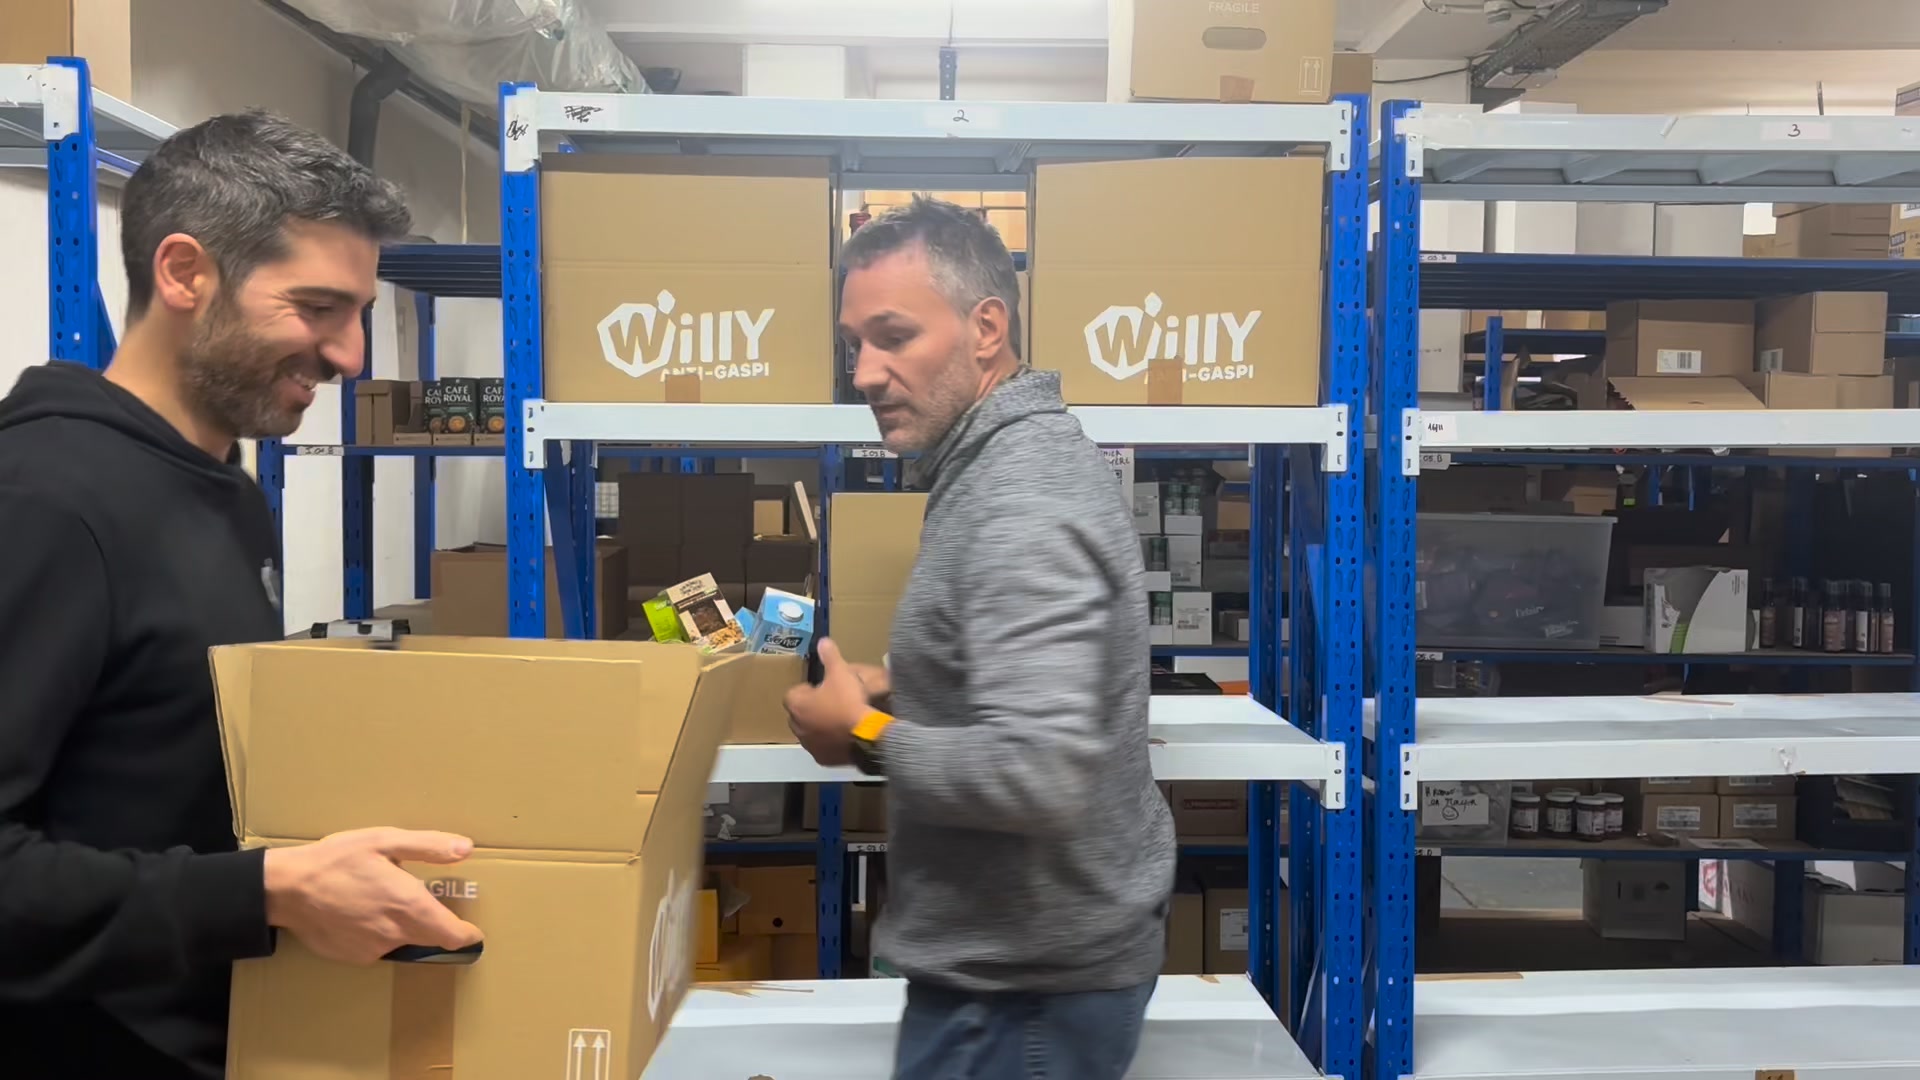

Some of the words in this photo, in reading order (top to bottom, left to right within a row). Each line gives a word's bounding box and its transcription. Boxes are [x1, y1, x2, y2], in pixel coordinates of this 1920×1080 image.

[1208, 1, 1260, 14] FRAGILE
[953, 109, 970, 123] 2
[1787, 123, 1801, 138] 3
[445, 384, 469, 394] CAFÉ
[484, 385, 504, 395] CAF
[425, 396, 442, 405] ROY
[443, 394, 472, 403] ROYAL
[483, 394, 505, 403] ROYA
